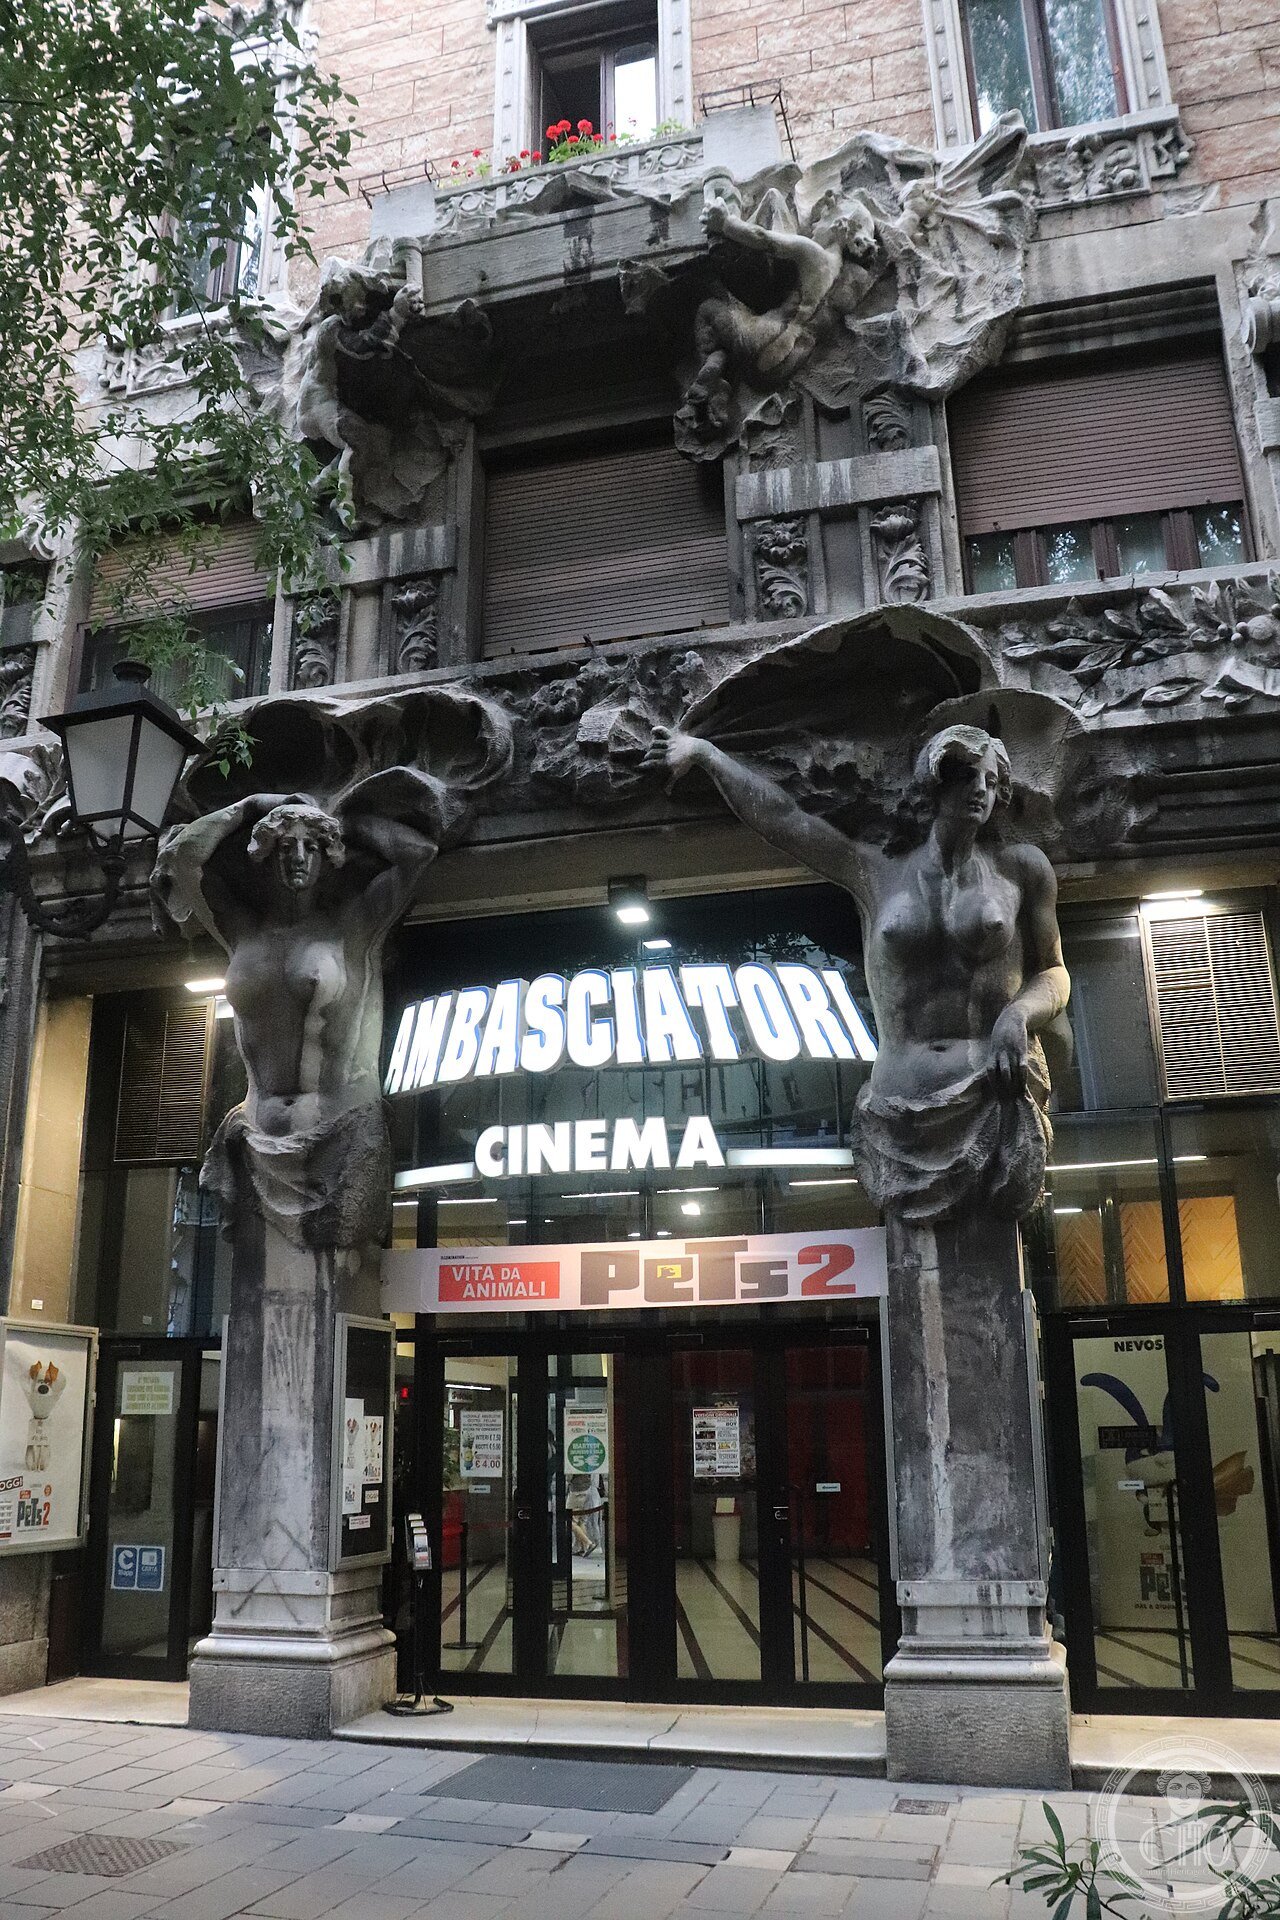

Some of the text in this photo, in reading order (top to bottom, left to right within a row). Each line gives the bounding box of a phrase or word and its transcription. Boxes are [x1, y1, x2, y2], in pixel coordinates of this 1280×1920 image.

[386, 962, 879, 1095] AMBASCIATORI
[474, 1115, 726, 1178] CINEMA
[452, 1265, 521, 1281] VITA DA
[797, 1243, 856, 1296] 2
[462, 1281, 546, 1298] ANIMALI
[1114, 1340, 1164, 1352] NEVOS
[0, 1477, 23, 1490] OGGI
[42, 1501, 51, 1526] 2
